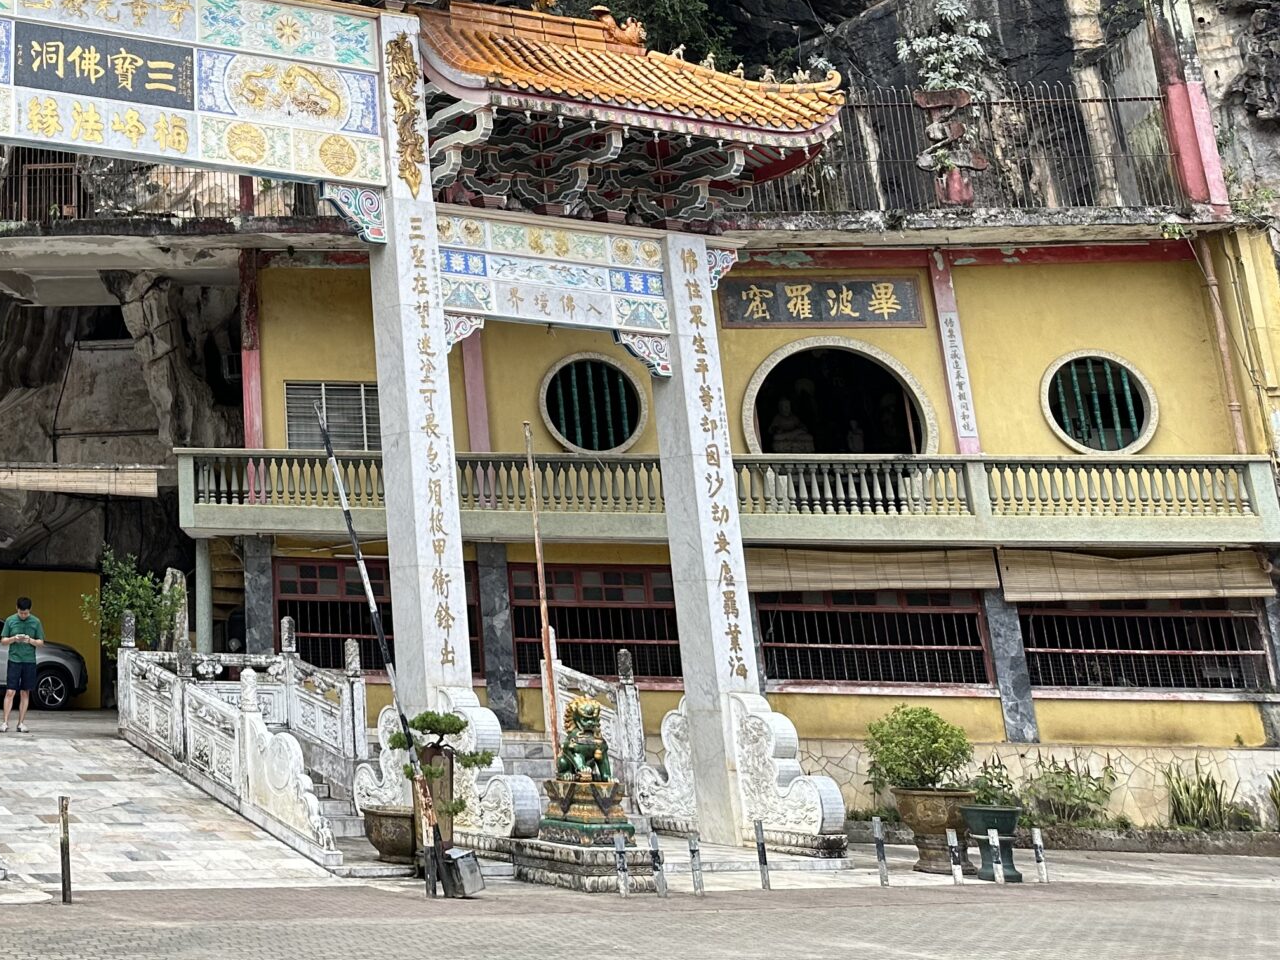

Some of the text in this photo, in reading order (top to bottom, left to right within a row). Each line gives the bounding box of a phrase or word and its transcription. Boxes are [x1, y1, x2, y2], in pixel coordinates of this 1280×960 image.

[30, 40, 177, 93] 三寶佛洞
[506, 286, 603, 321] 入佛境界
[741, 282, 903, 321] 畢波羅窟
